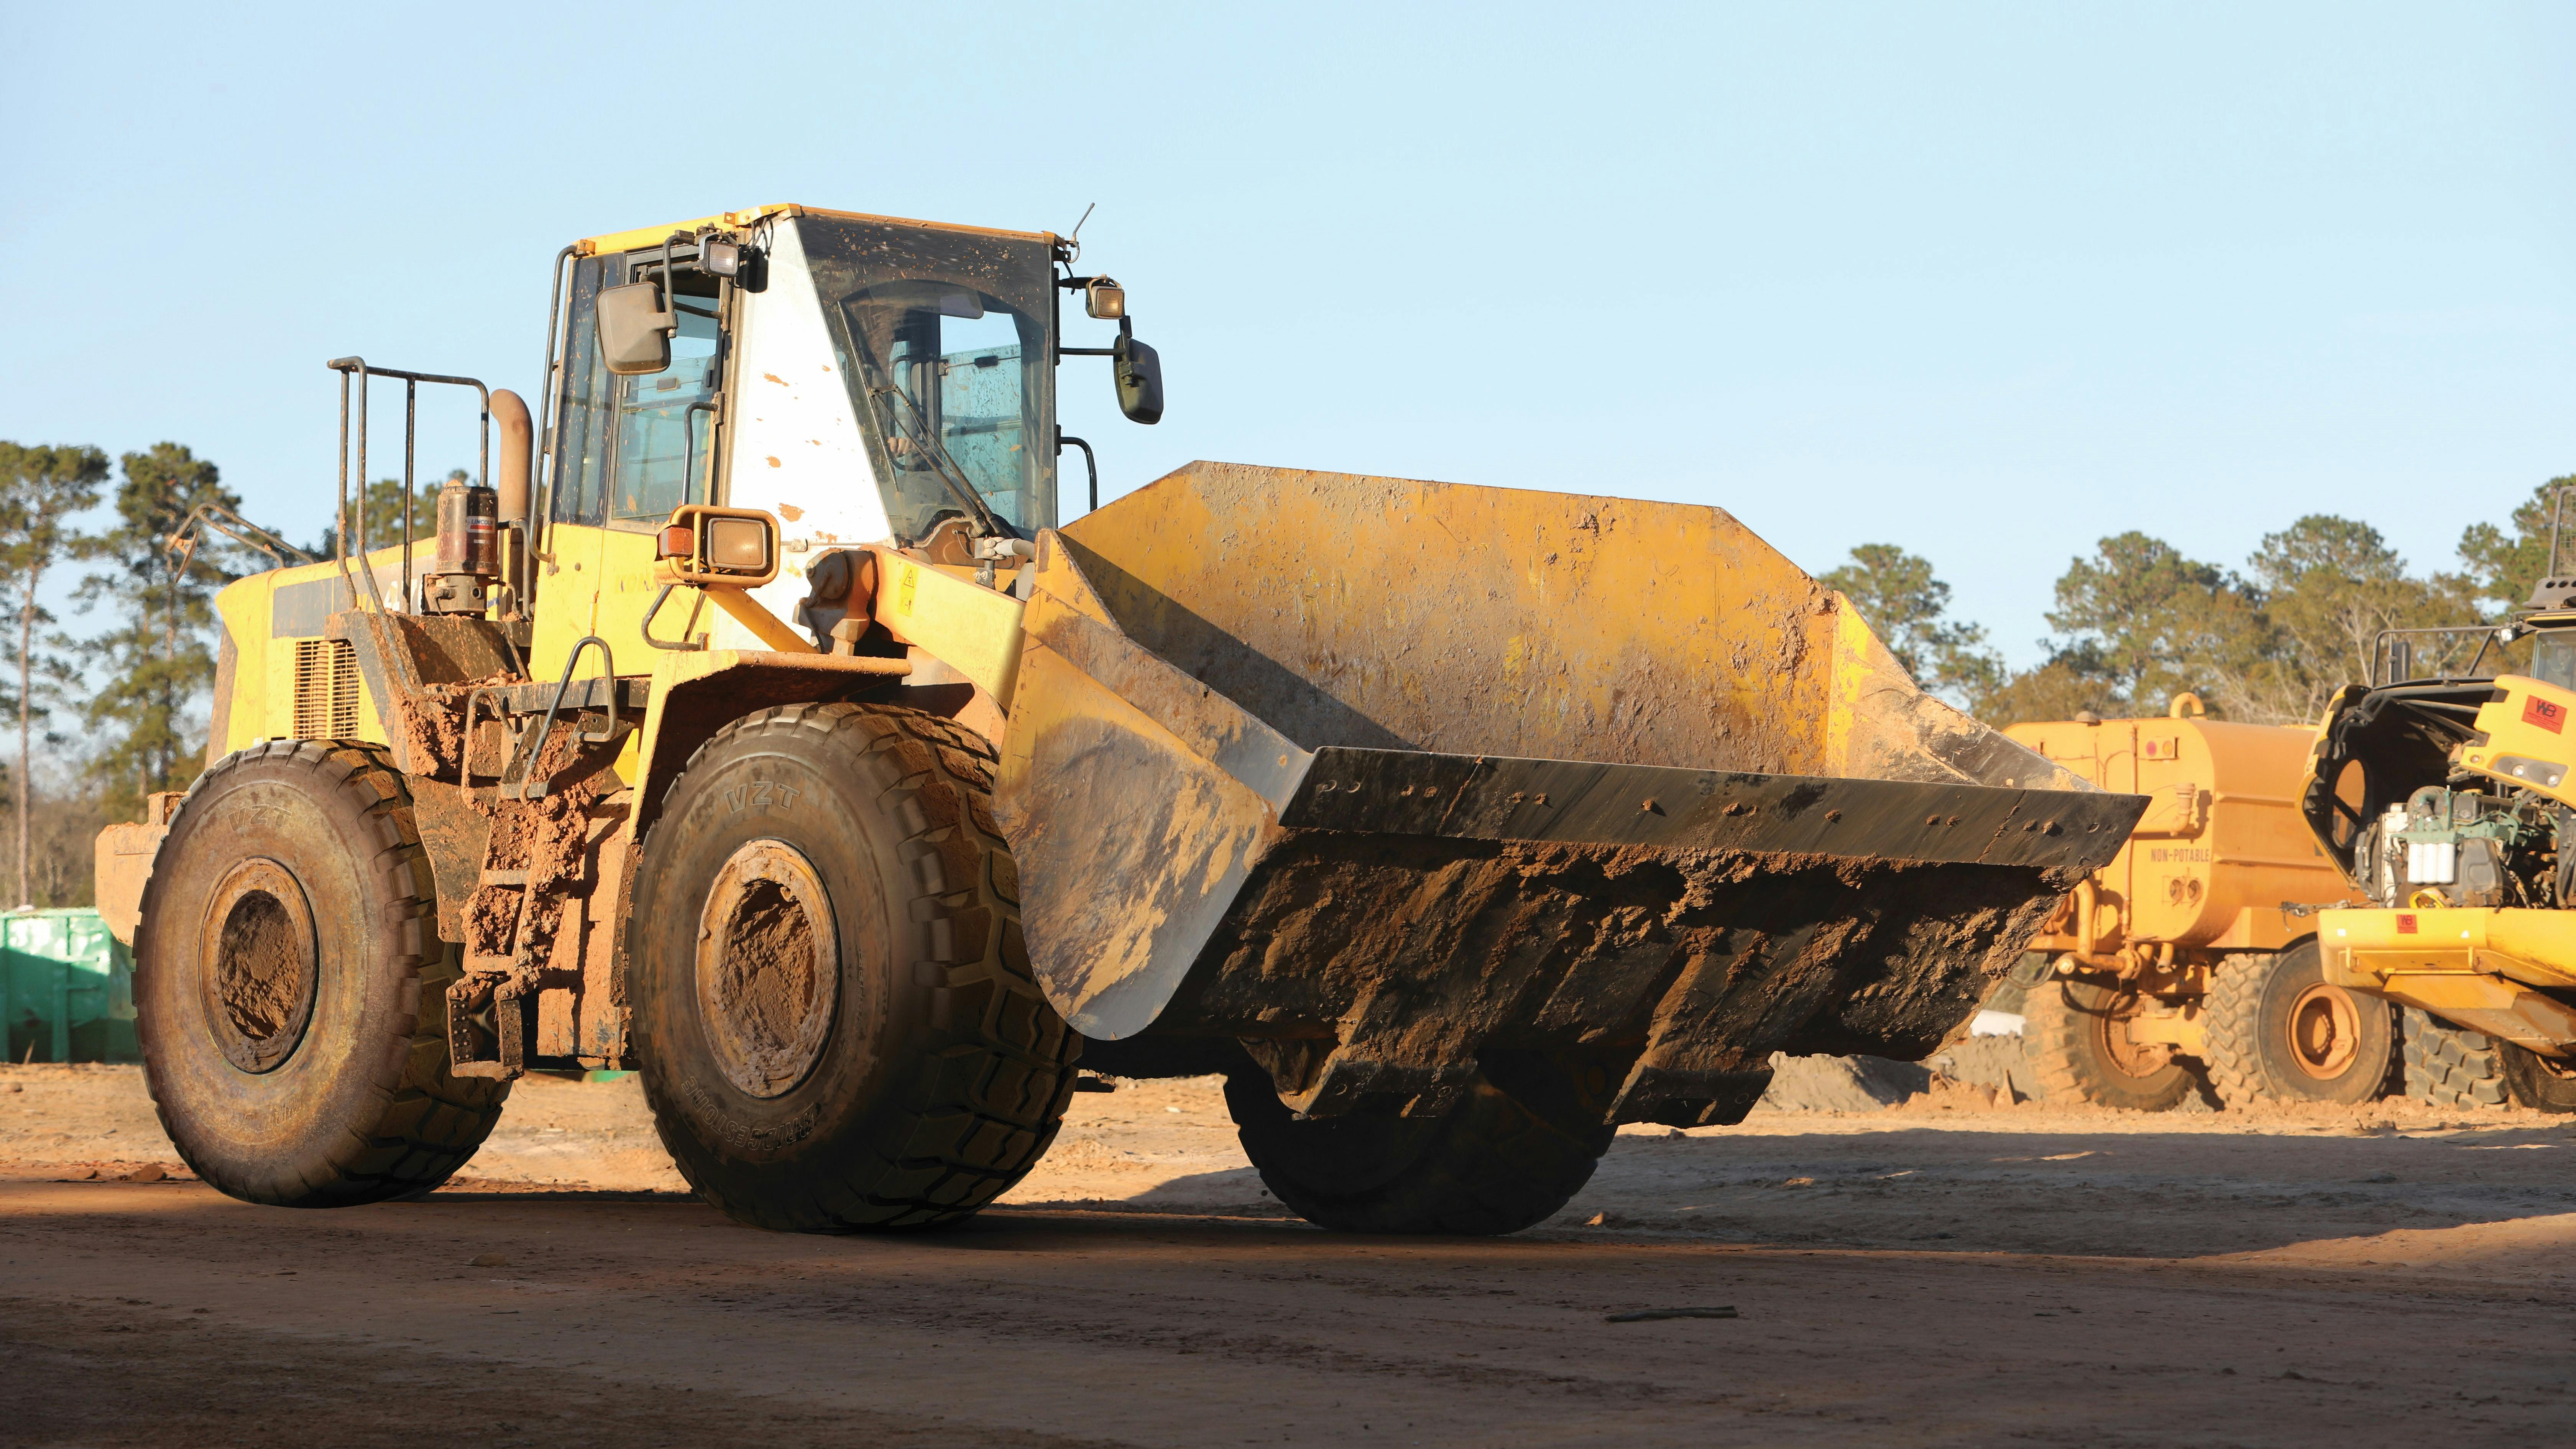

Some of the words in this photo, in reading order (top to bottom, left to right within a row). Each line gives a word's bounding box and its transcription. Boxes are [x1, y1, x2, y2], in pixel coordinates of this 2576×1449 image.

[724, 781, 801, 814] VZT
[227, 804, 292, 832] VZT
[2151, 849, 2209, 862] NON-POTABLE
[681, 1076, 814, 1150] BRIDGESTONE
